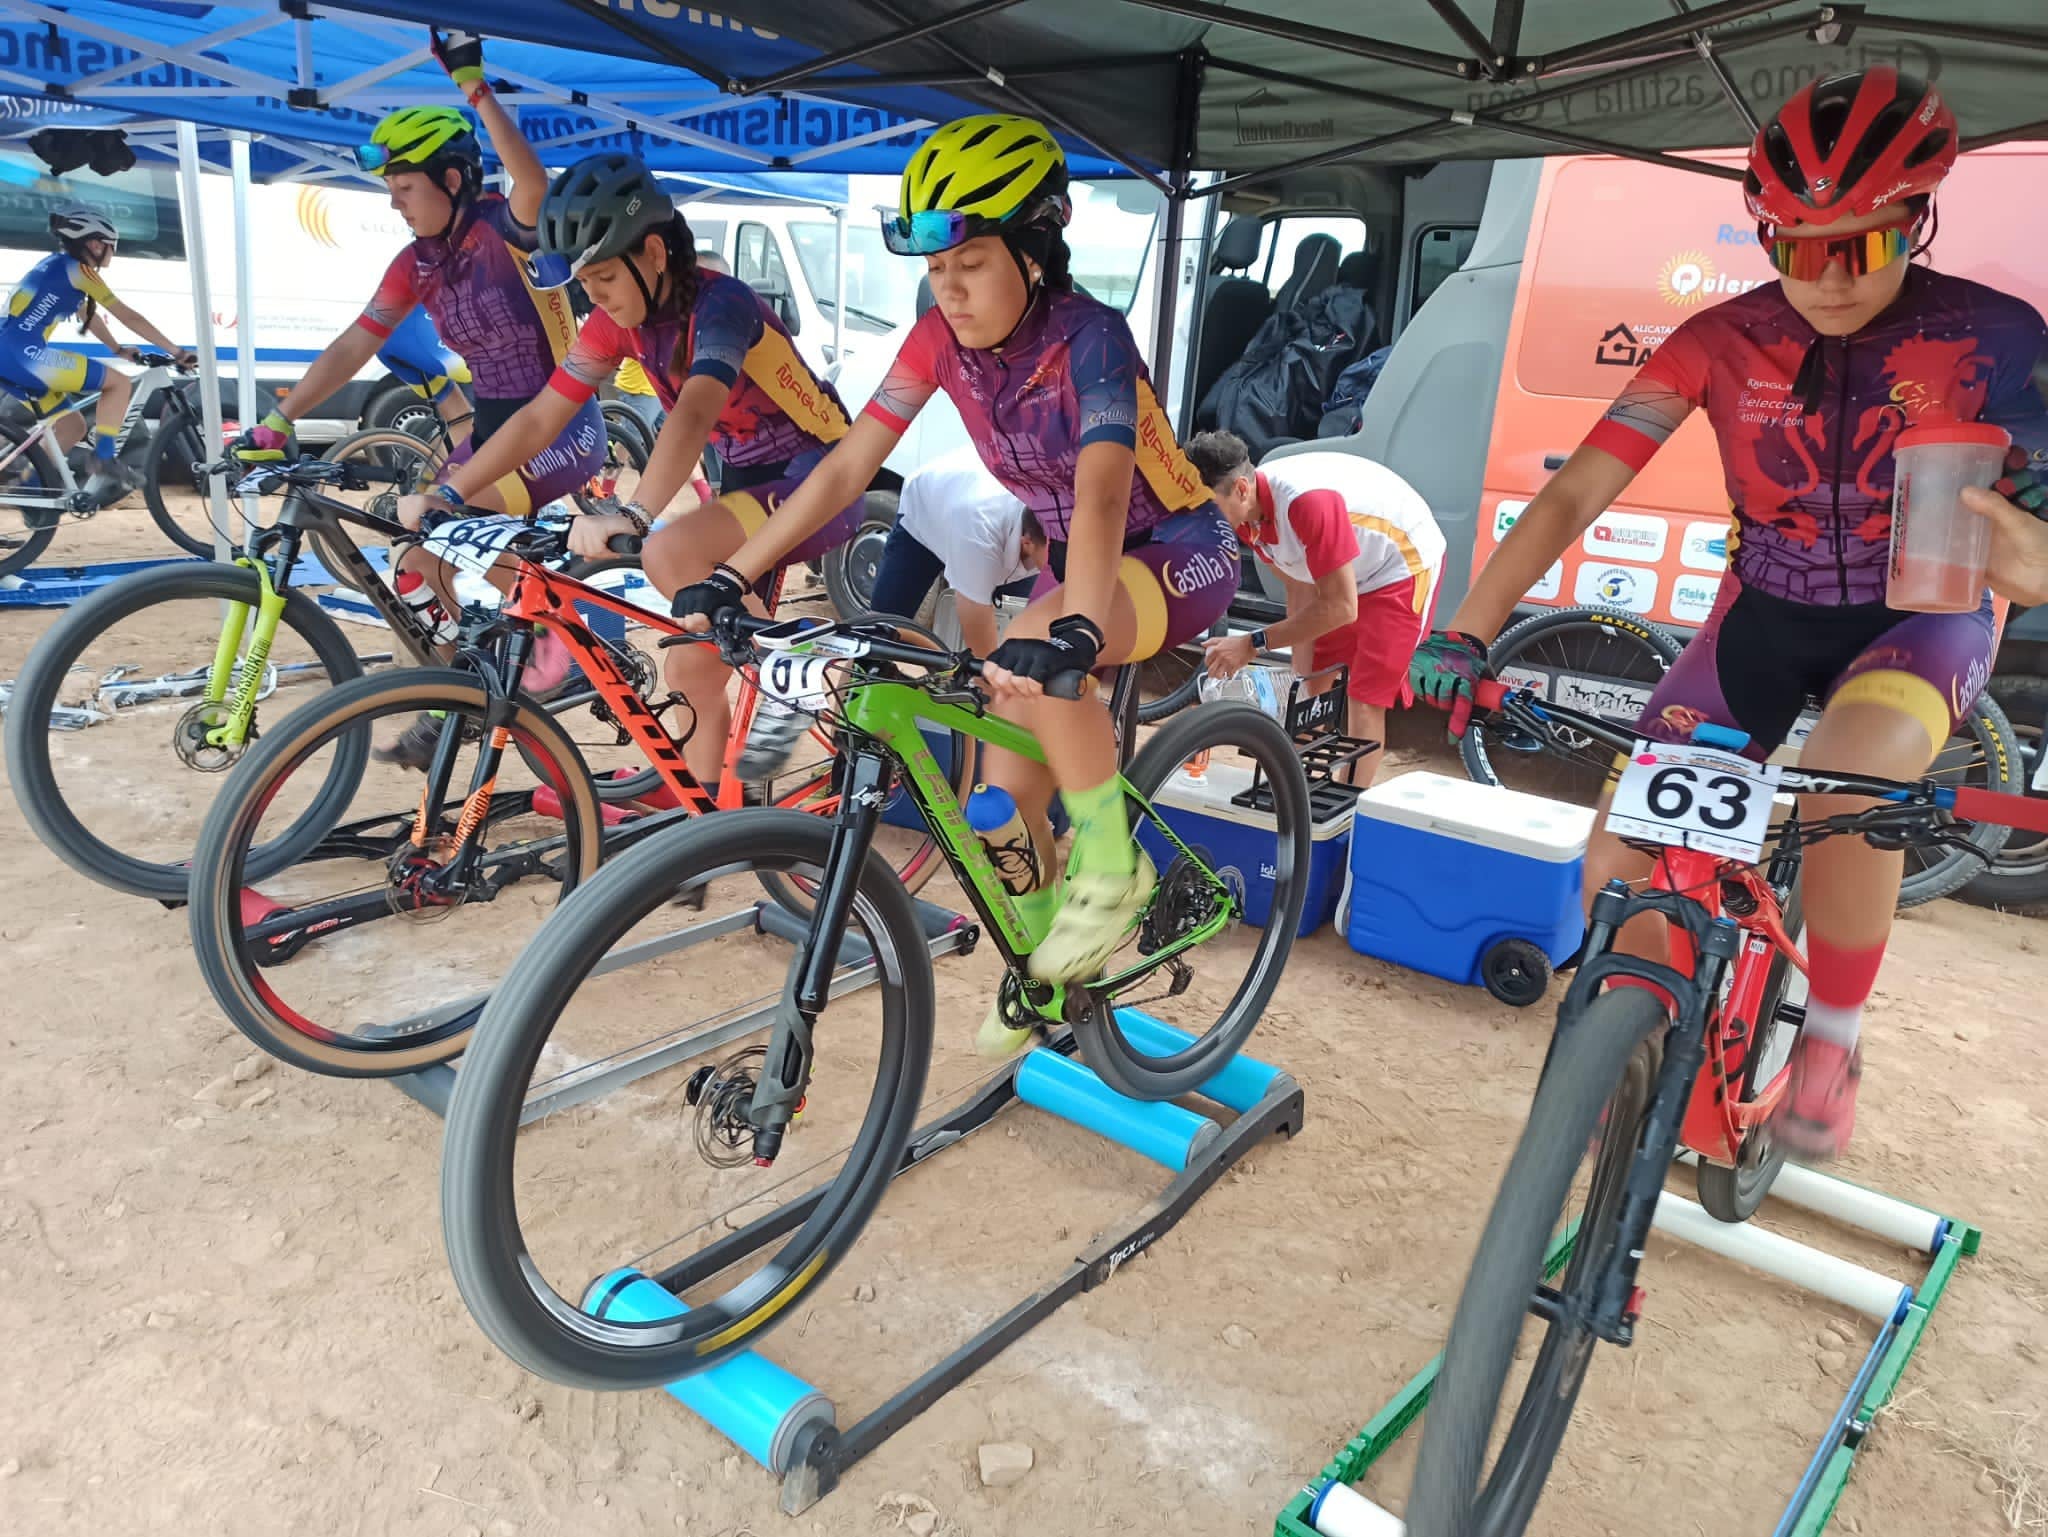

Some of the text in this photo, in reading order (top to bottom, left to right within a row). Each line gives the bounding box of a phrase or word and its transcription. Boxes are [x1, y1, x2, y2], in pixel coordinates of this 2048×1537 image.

[448, 519, 506, 559] 64
[1162, 552, 1226, 599] Castilla
[1589, 613, 1650, 639] MAXXIS
[1981, 716, 2009, 783] MAXXIS
[1646, 766, 1751, 830] 63
